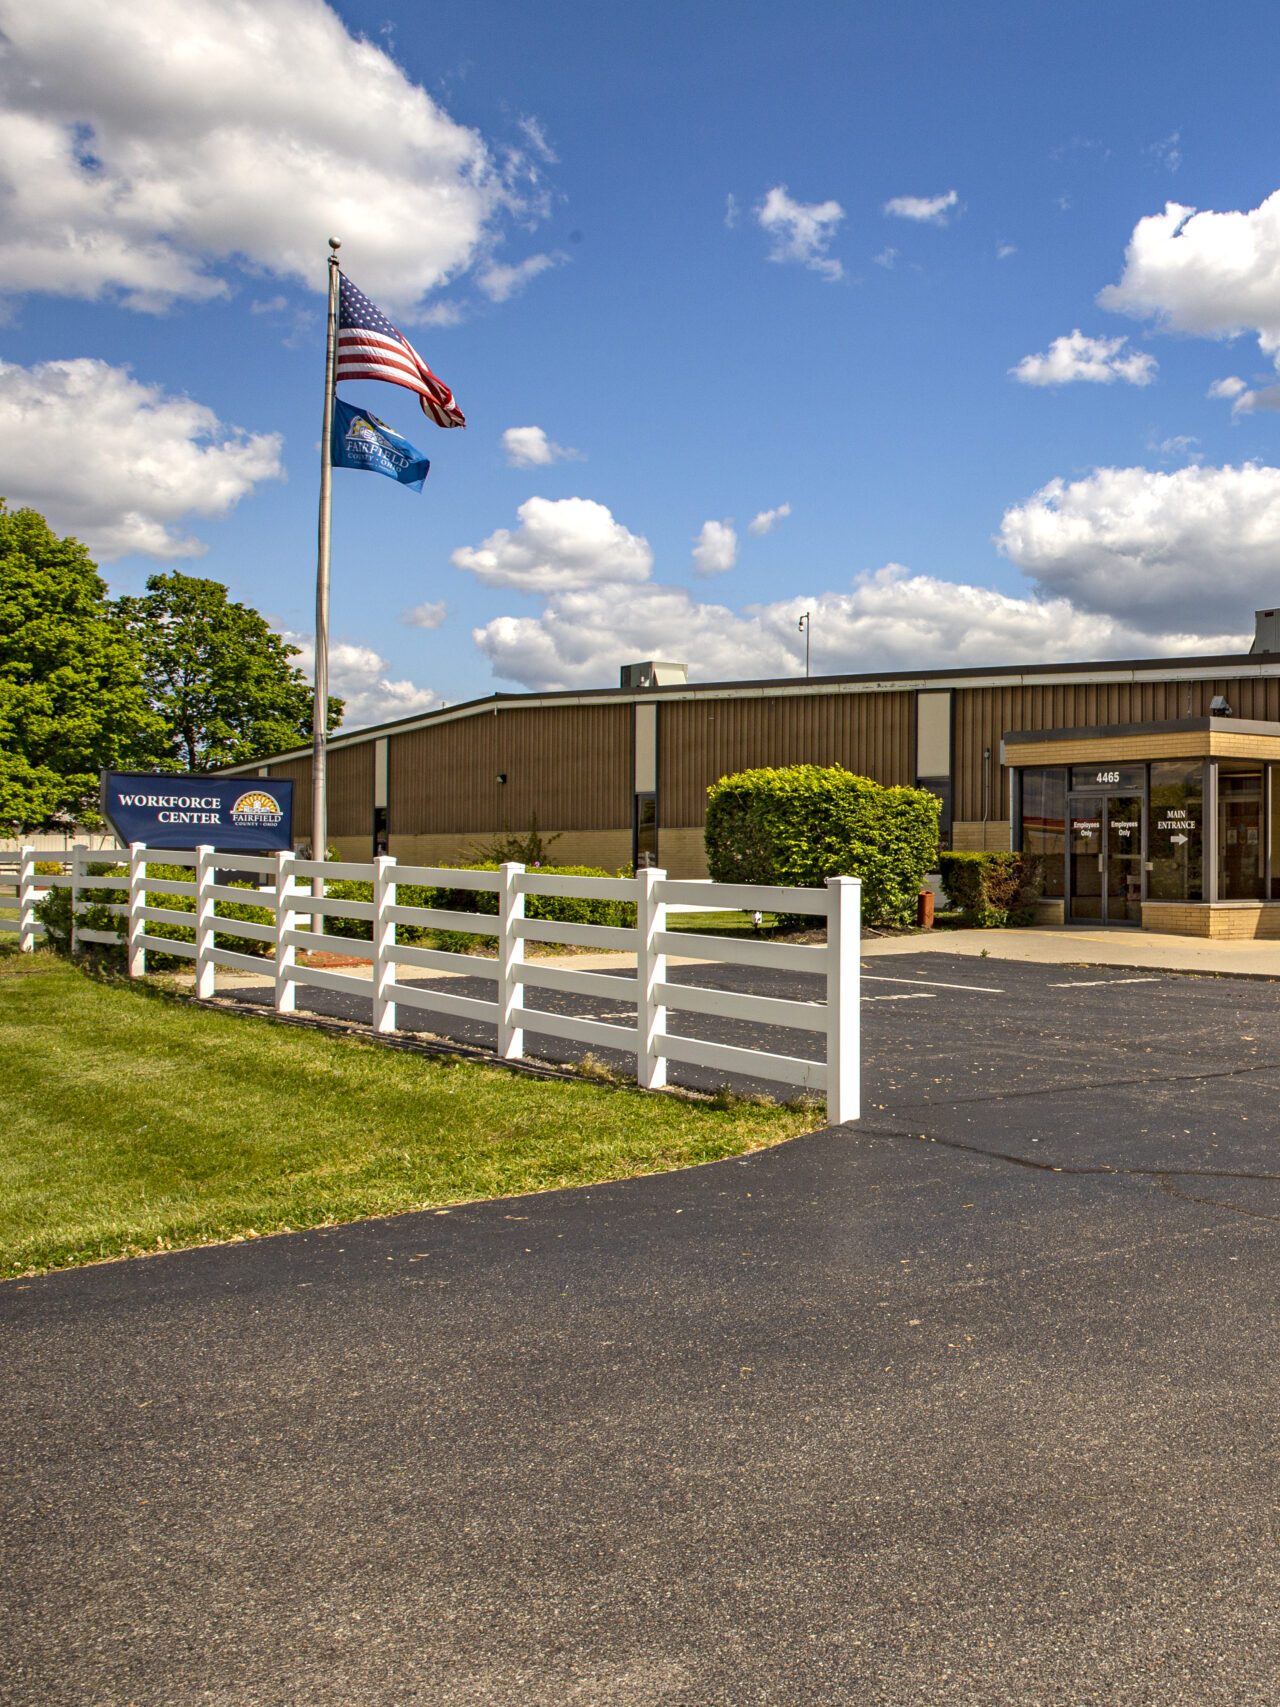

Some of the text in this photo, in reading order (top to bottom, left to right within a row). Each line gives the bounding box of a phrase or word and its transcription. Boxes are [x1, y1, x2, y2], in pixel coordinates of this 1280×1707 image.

[346, 441, 410, 468] FAIRFIELD
[1096, 771, 1120, 783] 4465
[118, 794, 221, 809] WORKFORCE
[158, 811, 221, 824] CENTER
[232, 814, 281, 823] FAIRFIELD
[1167, 810, 1186, 818] MAIN
[1073, 821, 1100, 829] Employees
[1111, 821, 1138, 829] Employees
[1157, 820, 1196, 829] ENTRANCE
[1080, 829, 1093, 838] Only
[1118, 829, 1131, 838] Only
